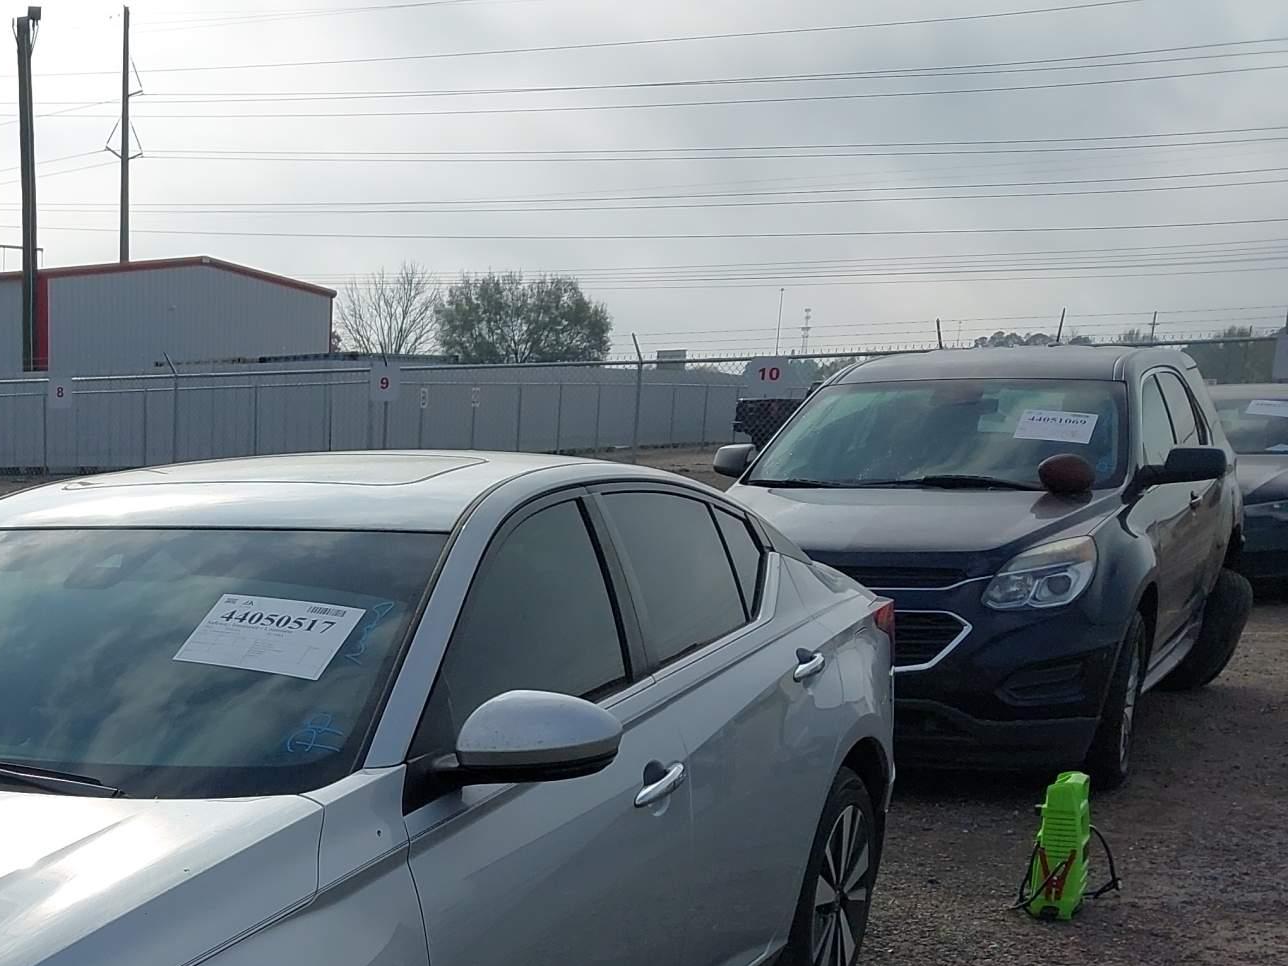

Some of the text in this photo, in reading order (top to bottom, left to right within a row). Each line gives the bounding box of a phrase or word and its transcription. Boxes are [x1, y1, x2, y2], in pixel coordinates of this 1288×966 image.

[758, 367, 780, 381] 10
[380, 376, 390, 390] 9
[56, 385, 64, 398] 8
[1028, 415, 1087, 425] 44051069
[220, 609, 337, 634] 44050517
